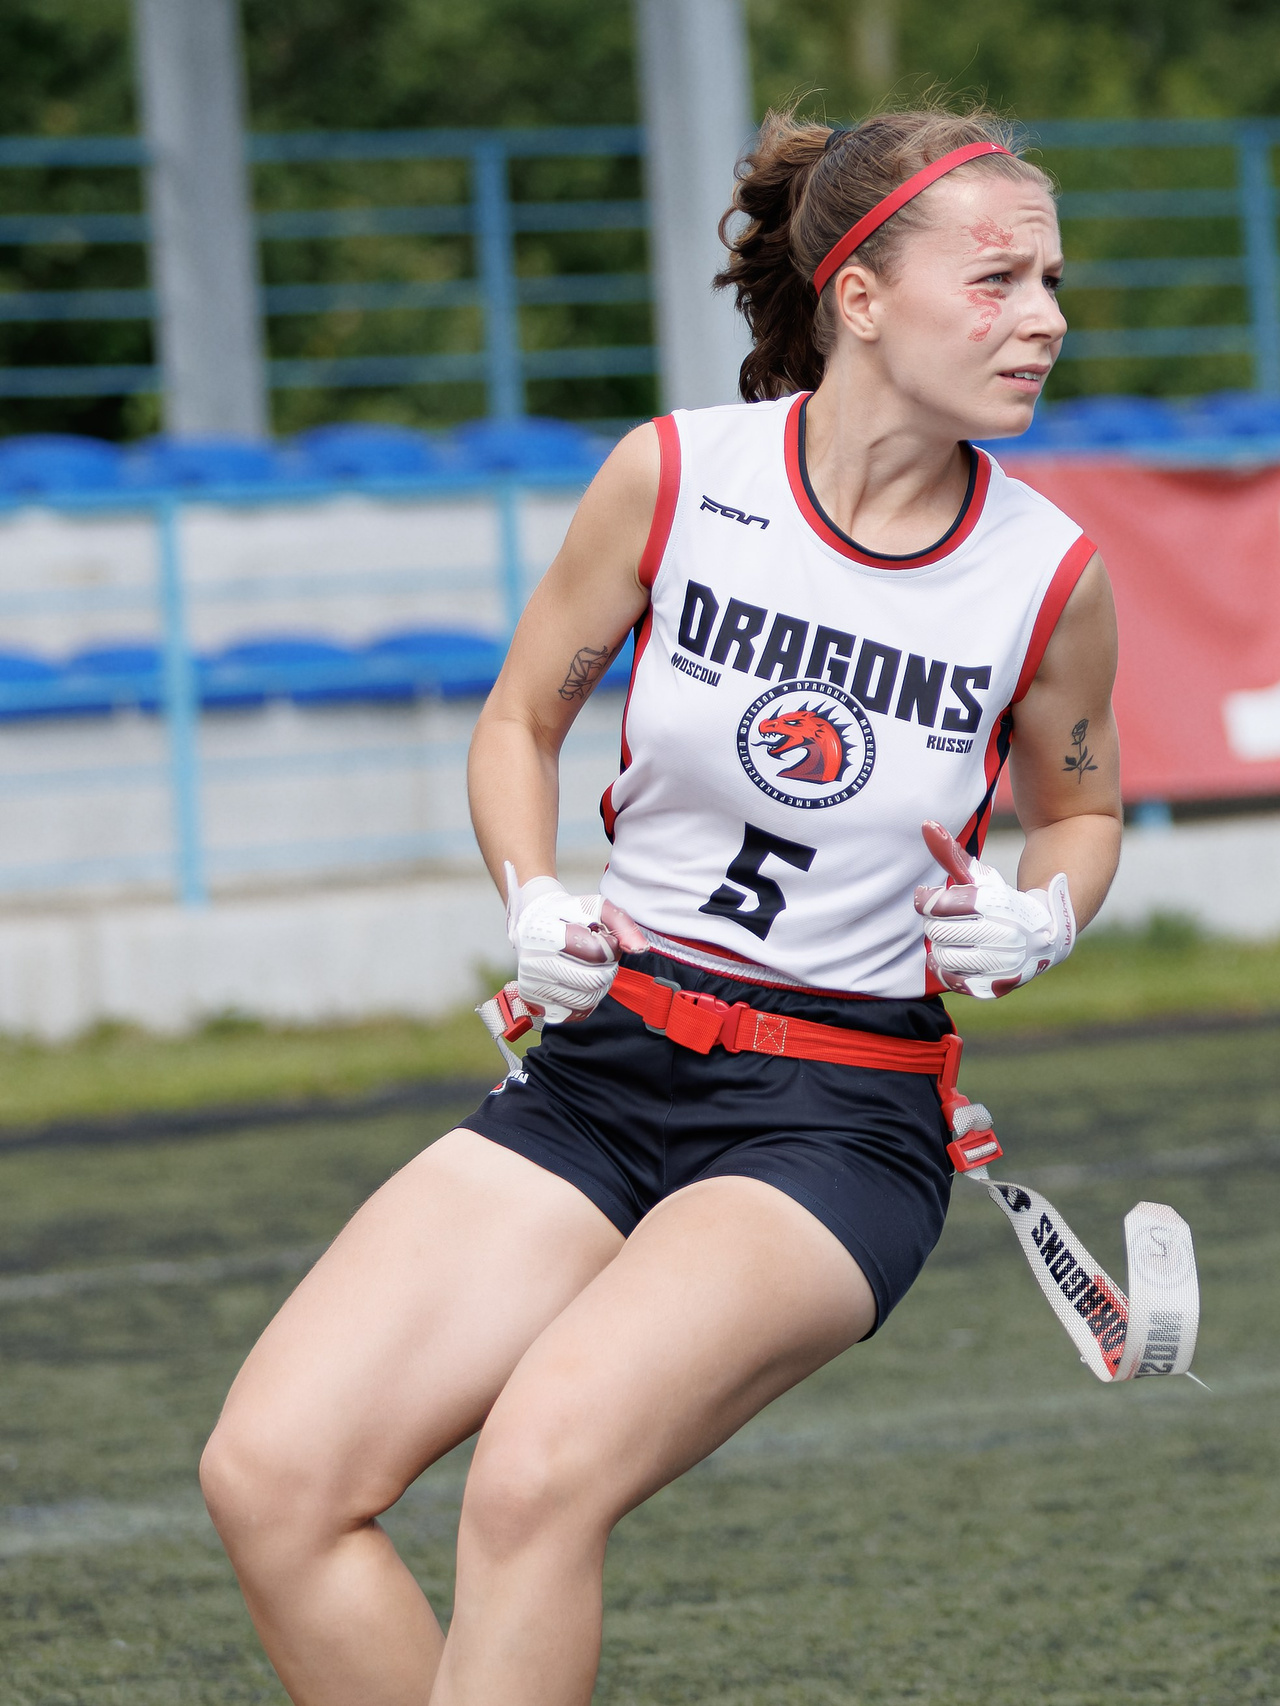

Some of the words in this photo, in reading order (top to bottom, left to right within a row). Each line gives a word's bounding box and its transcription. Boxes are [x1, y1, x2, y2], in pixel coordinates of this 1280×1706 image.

[671, 652, 722, 687] MOSCOW
[678, 579, 992, 734] DRAGONS
[698, 821, 818, 942] 5
